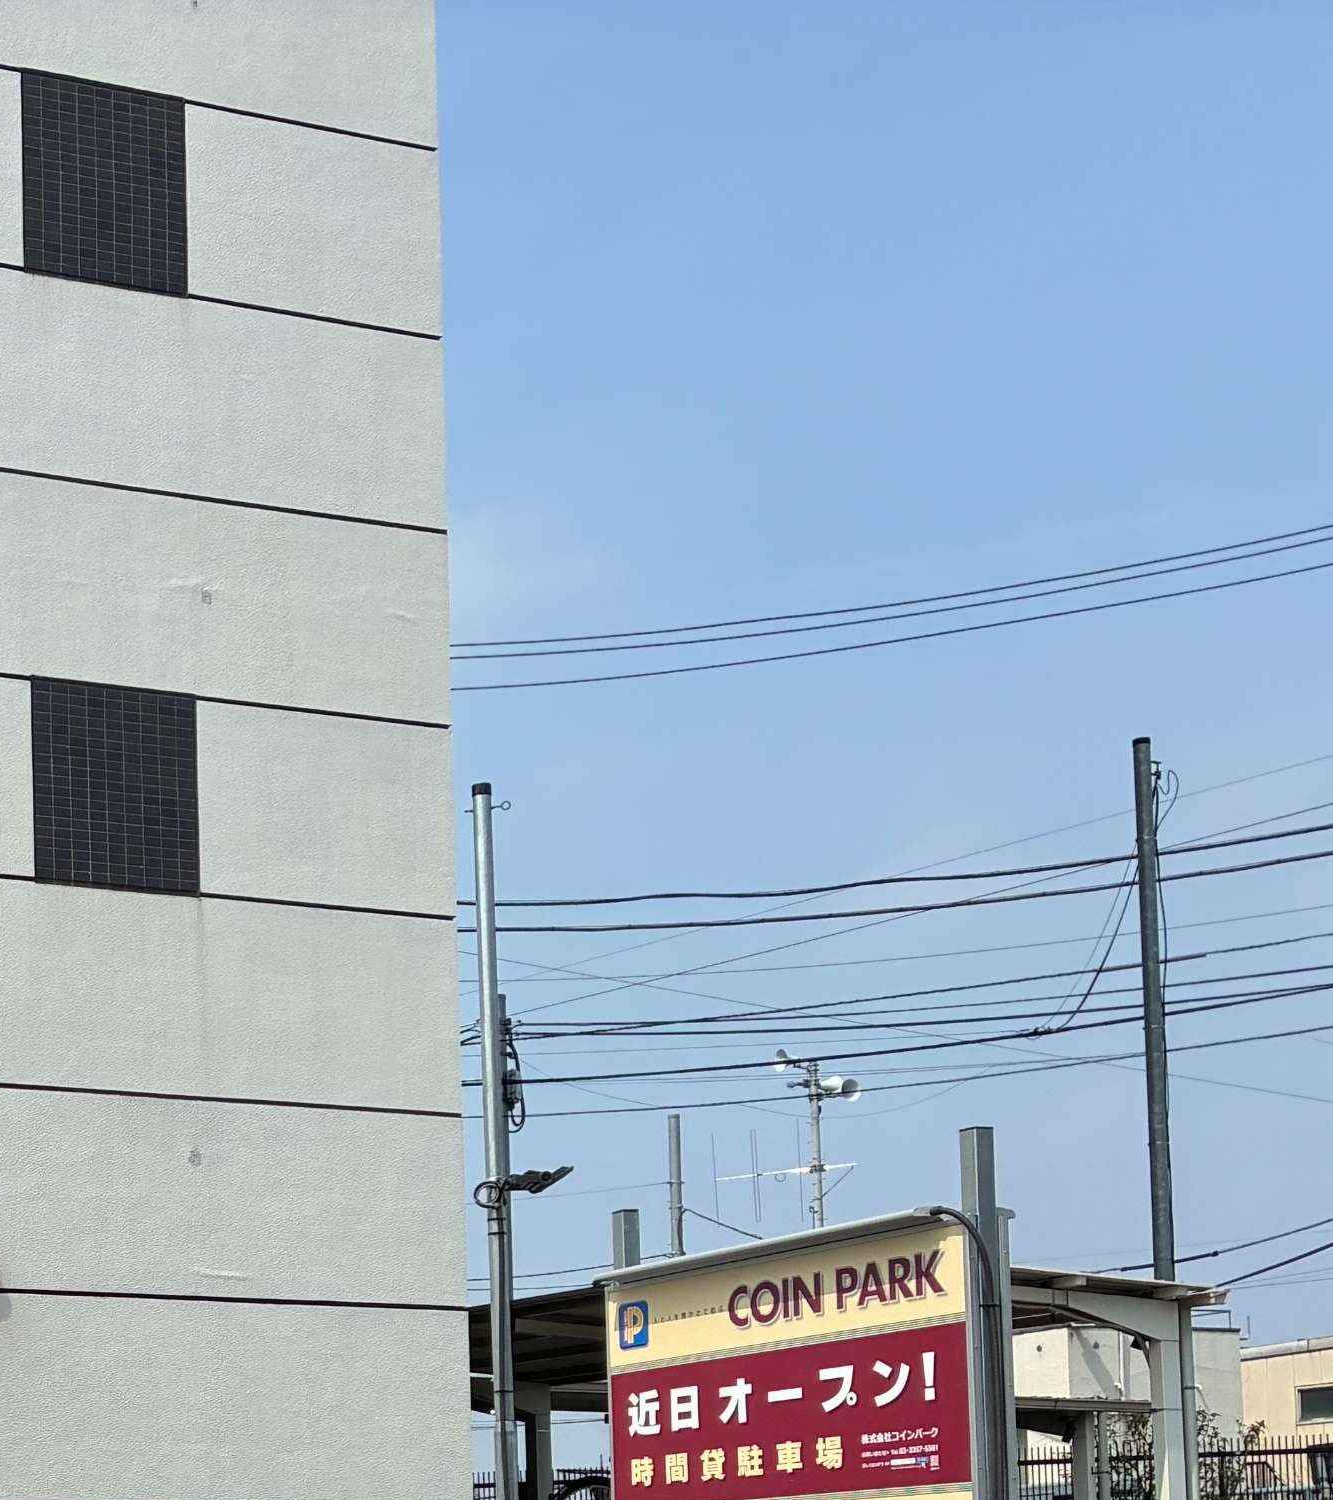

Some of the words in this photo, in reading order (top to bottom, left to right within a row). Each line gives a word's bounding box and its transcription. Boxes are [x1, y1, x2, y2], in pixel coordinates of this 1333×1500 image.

[727, 1271, 823, 1328] COIN
[835, 1249, 946, 1311] PARK
[627, 1351, 936, 1437] 近日オープン!
[630, 1436, 844, 1487] 時間貸駐車場
